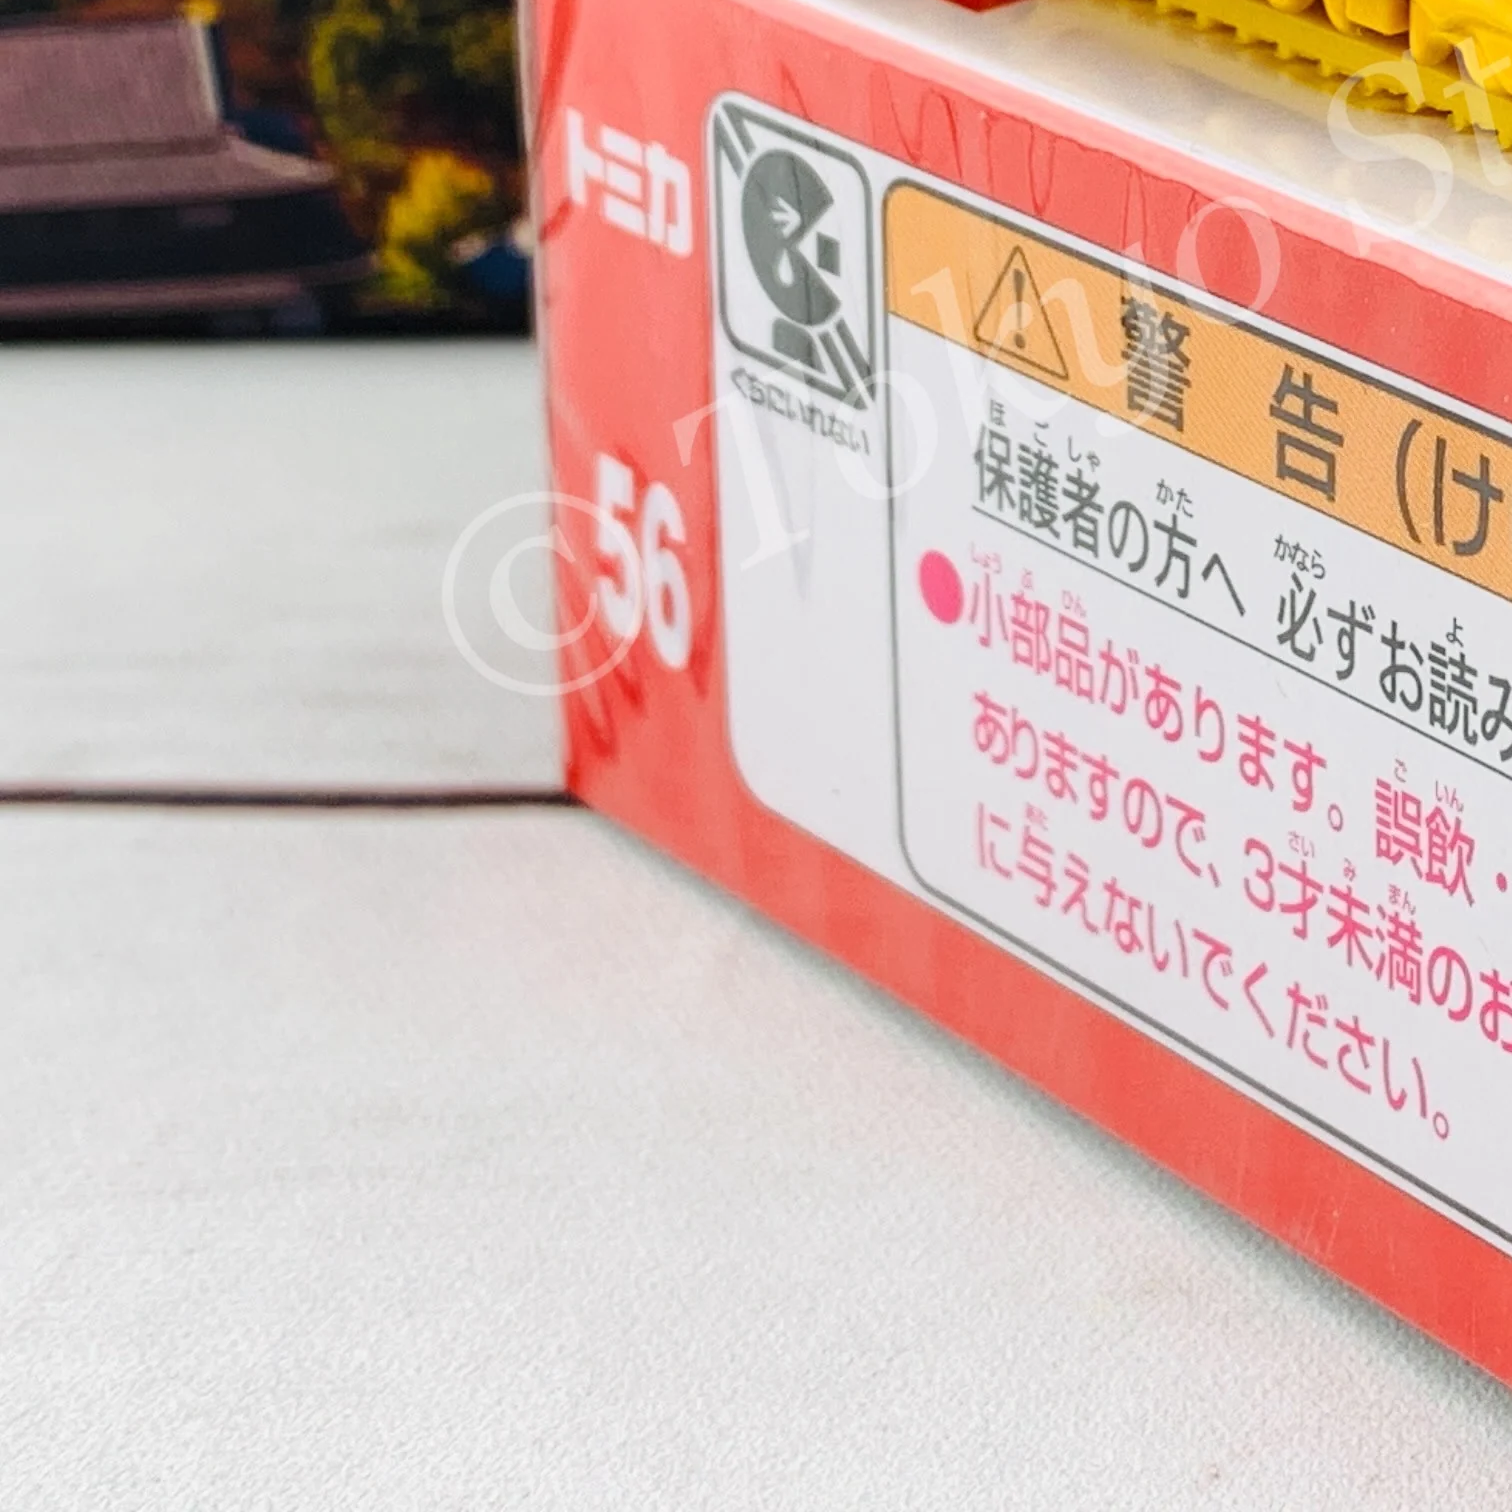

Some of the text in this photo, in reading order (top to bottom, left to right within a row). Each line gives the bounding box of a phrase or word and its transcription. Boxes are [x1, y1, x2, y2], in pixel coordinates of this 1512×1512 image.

[564, 106, 694, 258] トミカ
[594, 451, 693, 672] 56
[973, 424, 1247, 618] 保護者の方へ
[974, 798, 1451, 1141] に与えないでください。
